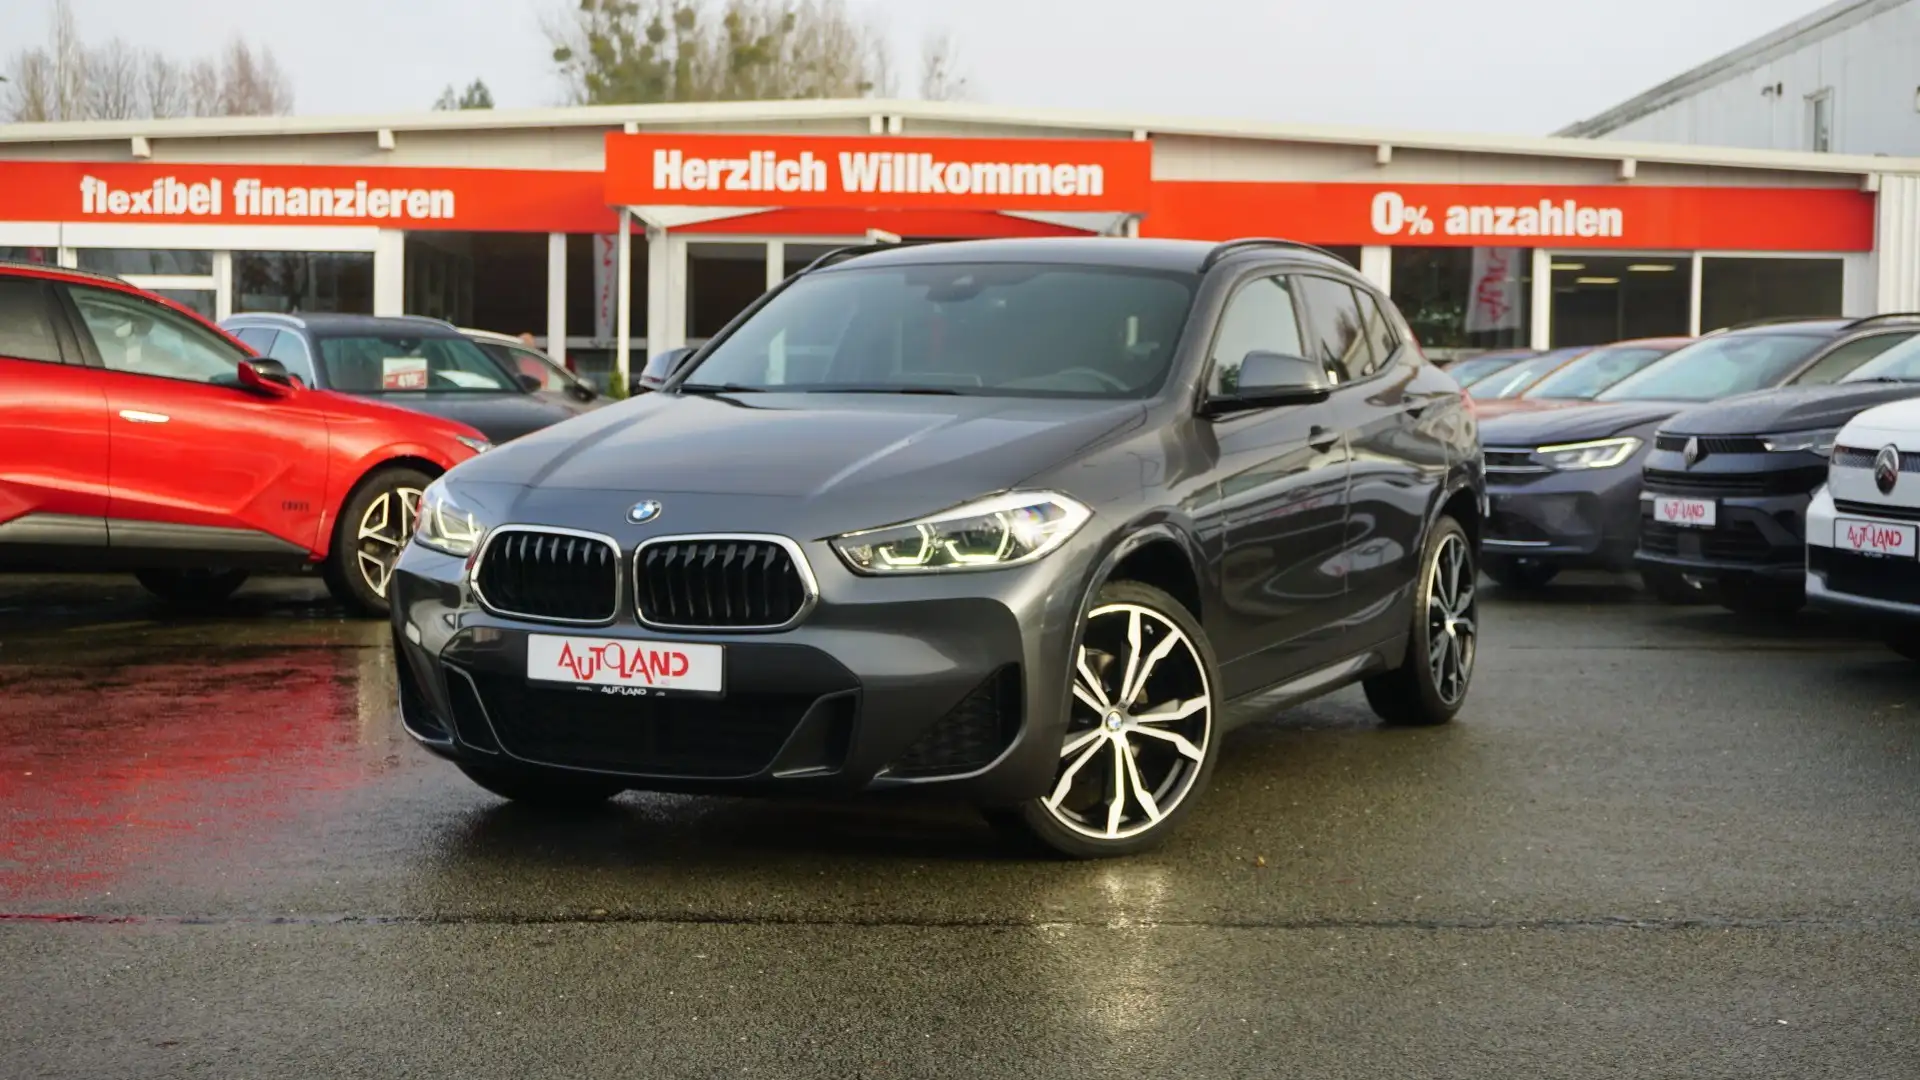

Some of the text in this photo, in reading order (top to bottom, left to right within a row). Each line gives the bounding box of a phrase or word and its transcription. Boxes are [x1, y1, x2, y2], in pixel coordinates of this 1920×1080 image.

[653, 149, 1104, 196] Herzlich Willkommen
[80, 175, 455, 219] flexibel finanzieren
[1371, 191, 1623, 237] 0% anzahlen
[557, 640, 689, 685] AUTOLAND
